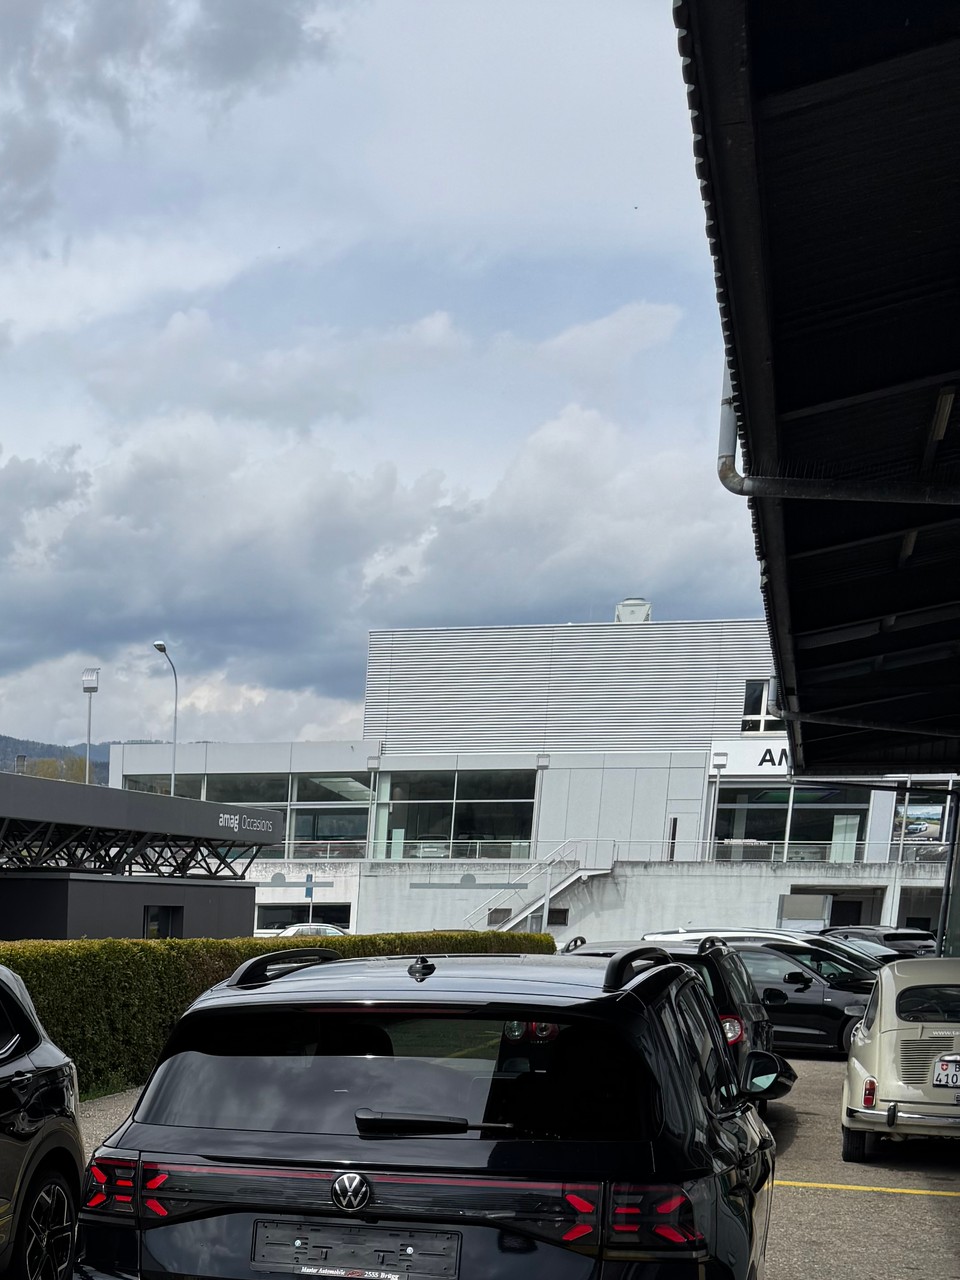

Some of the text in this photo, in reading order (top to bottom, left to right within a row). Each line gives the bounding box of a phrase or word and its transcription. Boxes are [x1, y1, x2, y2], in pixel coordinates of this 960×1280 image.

[219, 813, 272, 832] amag Occasions
[935, 1073, 958, 1084] 410
[364, 1271, 379, 1279] 2555
